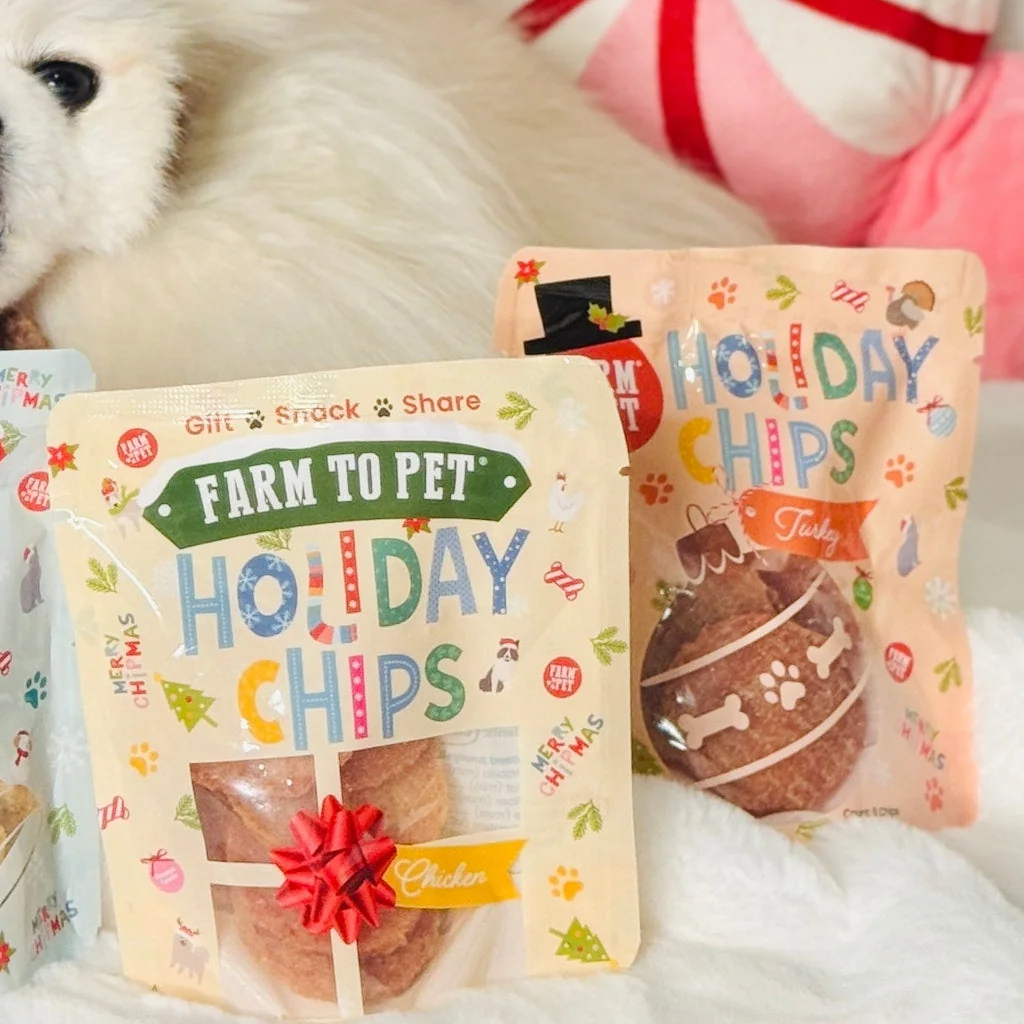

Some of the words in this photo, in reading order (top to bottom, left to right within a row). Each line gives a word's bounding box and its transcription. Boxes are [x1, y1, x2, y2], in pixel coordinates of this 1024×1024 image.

[667, 323, 940, 410] HOLIDAY
[185, 411, 234, 436] Gift
[275, 399, 361, 426] Snack
[403, 393, 481, 415] Share
[678, 408, 858, 489] CHIPS
[195, 458, 317, 524] FARM
[327, 452, 382, 502] TO
[394, 451, 475, 502] PET
[176, 526, 530, 656] HOLIDAY
[104, 634, 128, 694] MERRY
[237, 643, 466, 751] CHIPS
[531, 716, 574, 773] MERRY
[394, 858, 488, 897] Chicken
